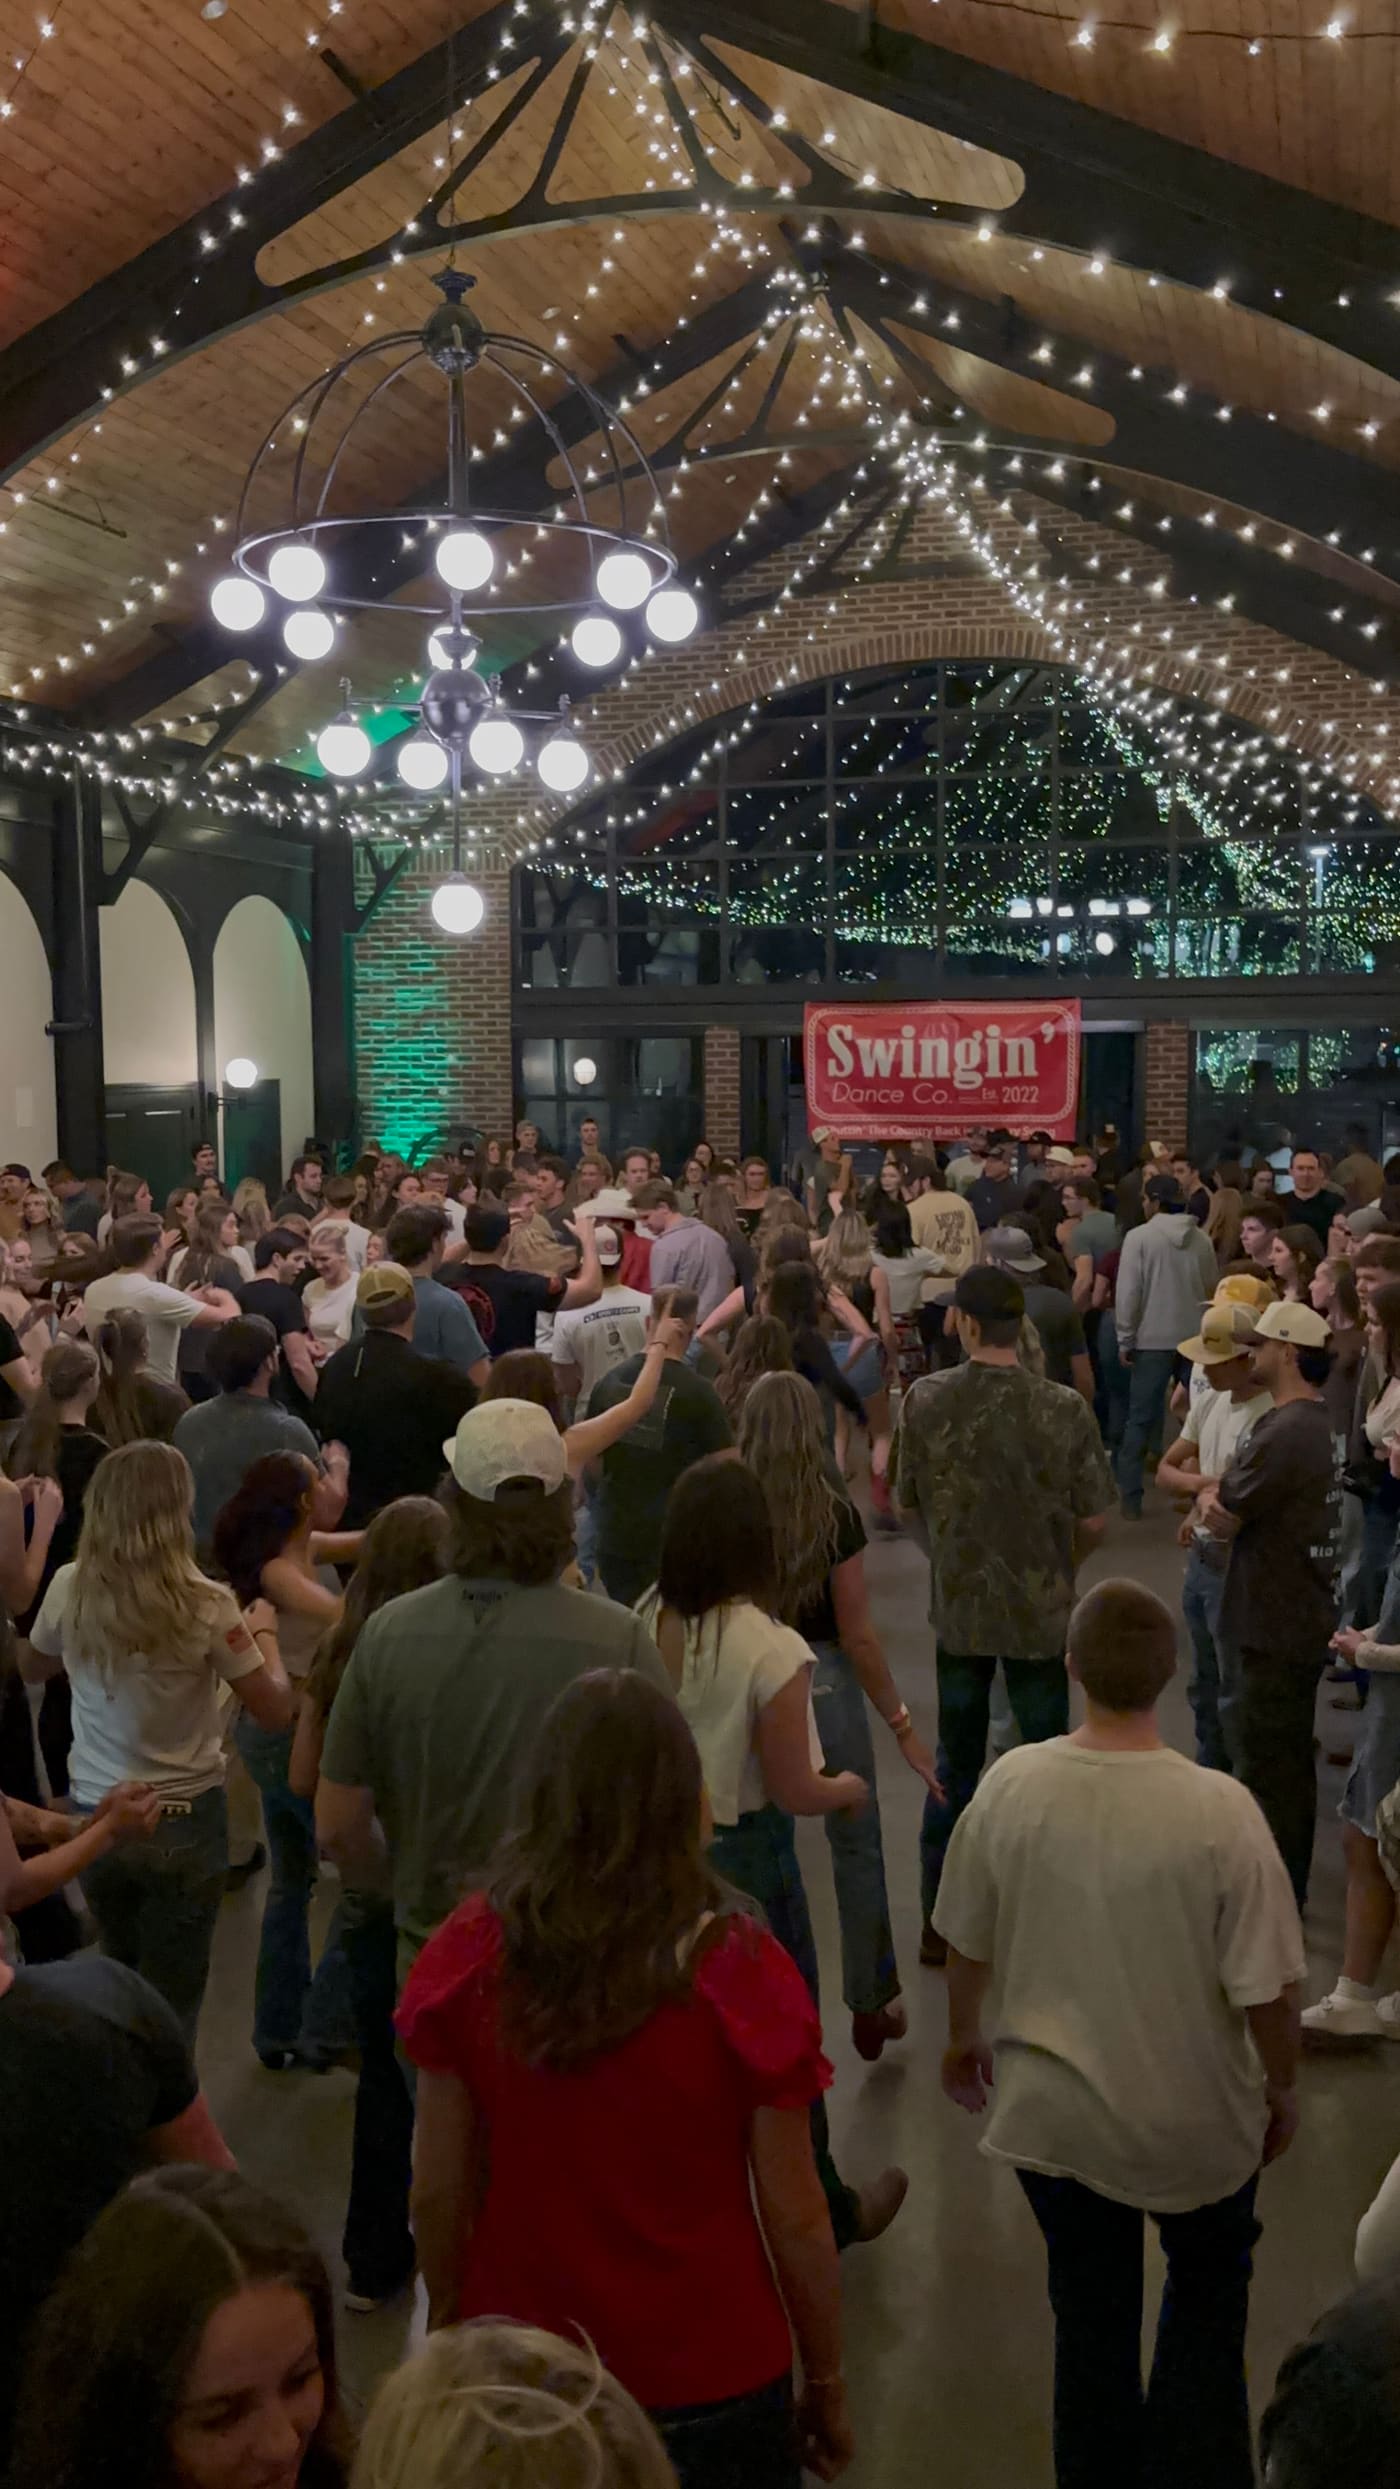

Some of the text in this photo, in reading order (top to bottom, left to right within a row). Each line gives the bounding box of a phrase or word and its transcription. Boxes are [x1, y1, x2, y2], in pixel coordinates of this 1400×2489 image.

[826, 1022, 1055, 1090] Swingin'
[832, 1081, 905, 1104] Dance
[912, 1082, 953, 1104] Co.
[1002, 1086, 1039, 1104] 2022
[868, 1125, 888, 1136] The
[889, 1125, 934, 1139] Country
[935, 1126, 962, 1136] Back
